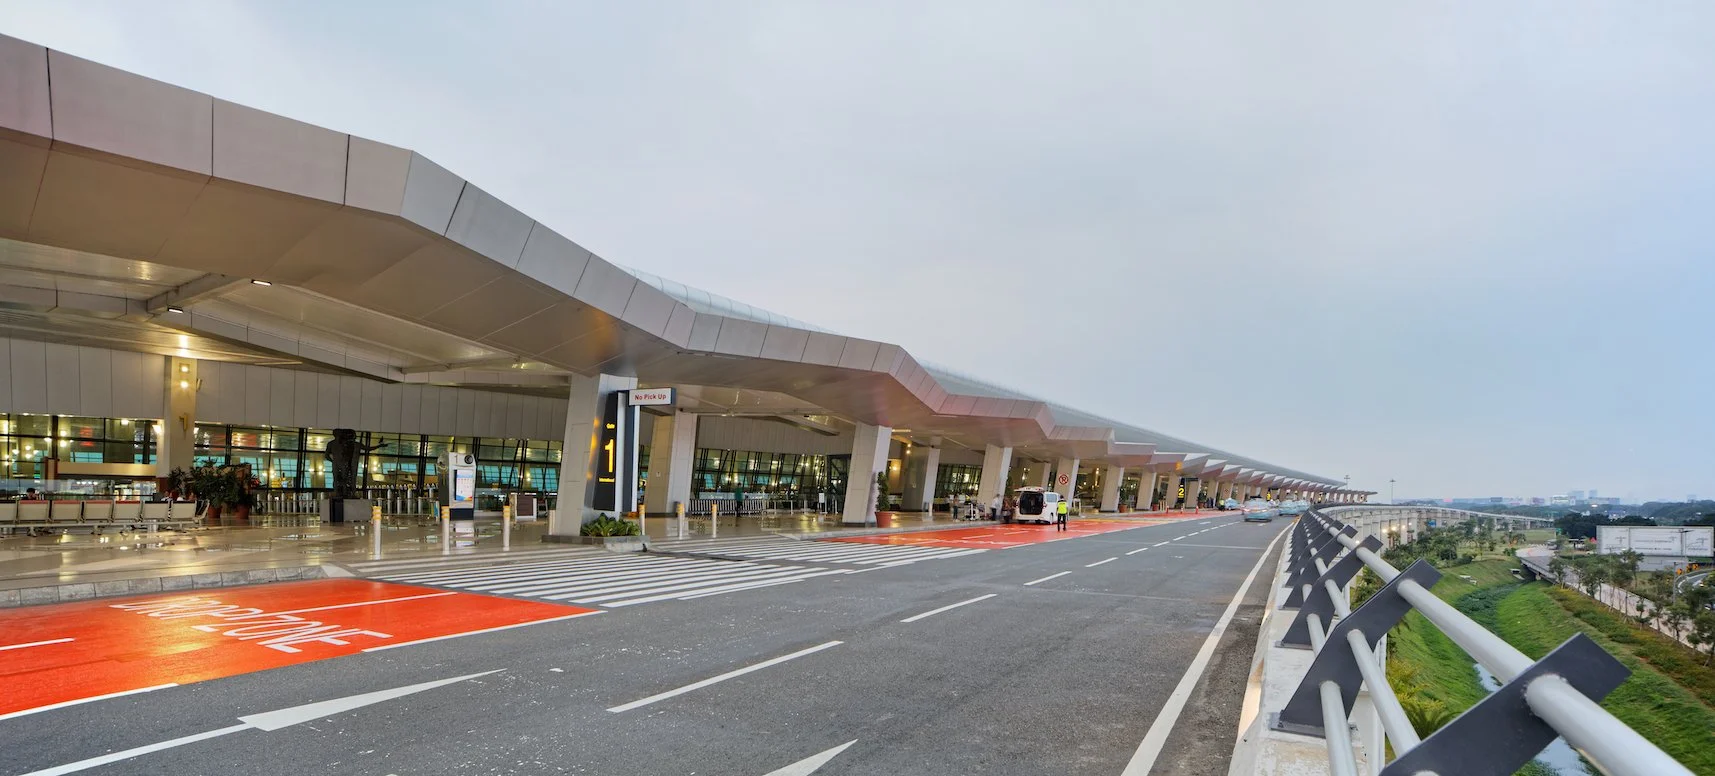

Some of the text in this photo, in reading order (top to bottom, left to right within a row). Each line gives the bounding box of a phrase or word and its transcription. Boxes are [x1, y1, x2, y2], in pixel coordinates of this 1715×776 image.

[604, 438, 614, 473] 1
[1178, 487, 1185, 496] 2
[191, 614, 394, 653] ZONE
